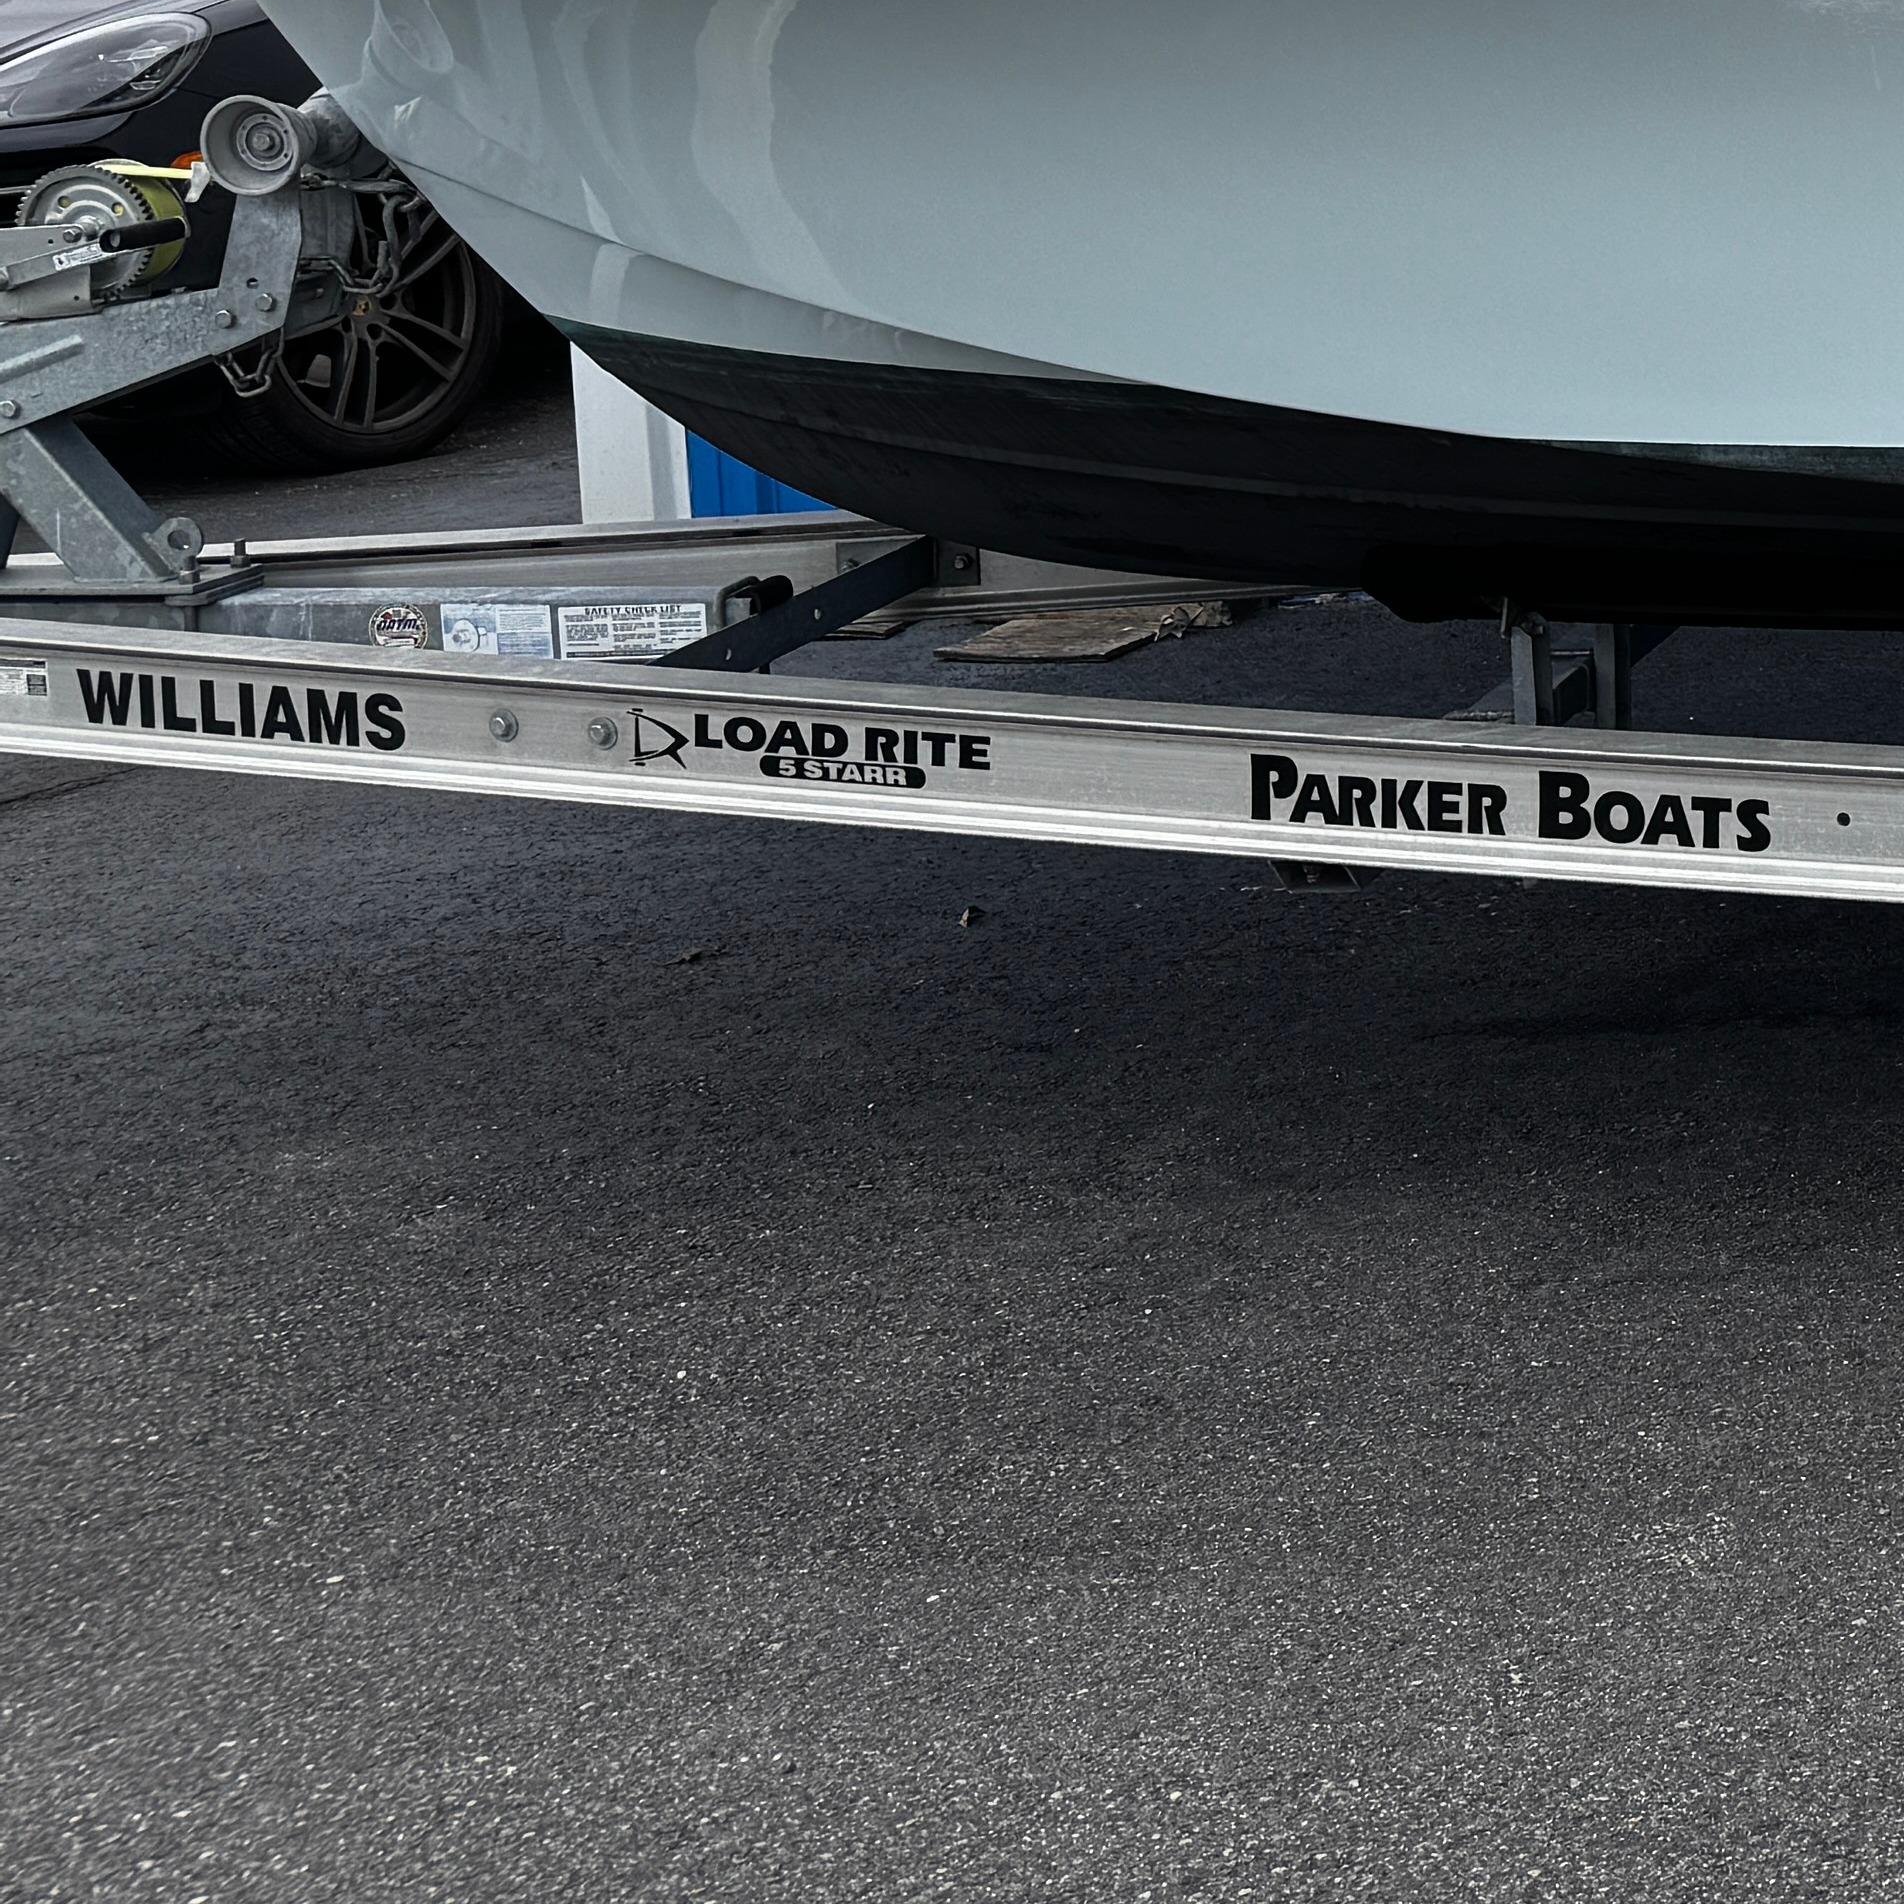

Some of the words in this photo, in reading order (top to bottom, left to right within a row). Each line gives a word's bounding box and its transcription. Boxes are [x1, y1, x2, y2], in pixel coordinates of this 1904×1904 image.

[76, 668, 407, 751] WILLIAMS
[693, 713, 850, 759] LOAD
[864, 726, 992, 771] RITE
[778, 759, 798, 778] 5
[803, 760, 908, 787] STARR
[1250, 752, 1508, 837] PARKER
[1536, 769, 1772, 853] BOATS
